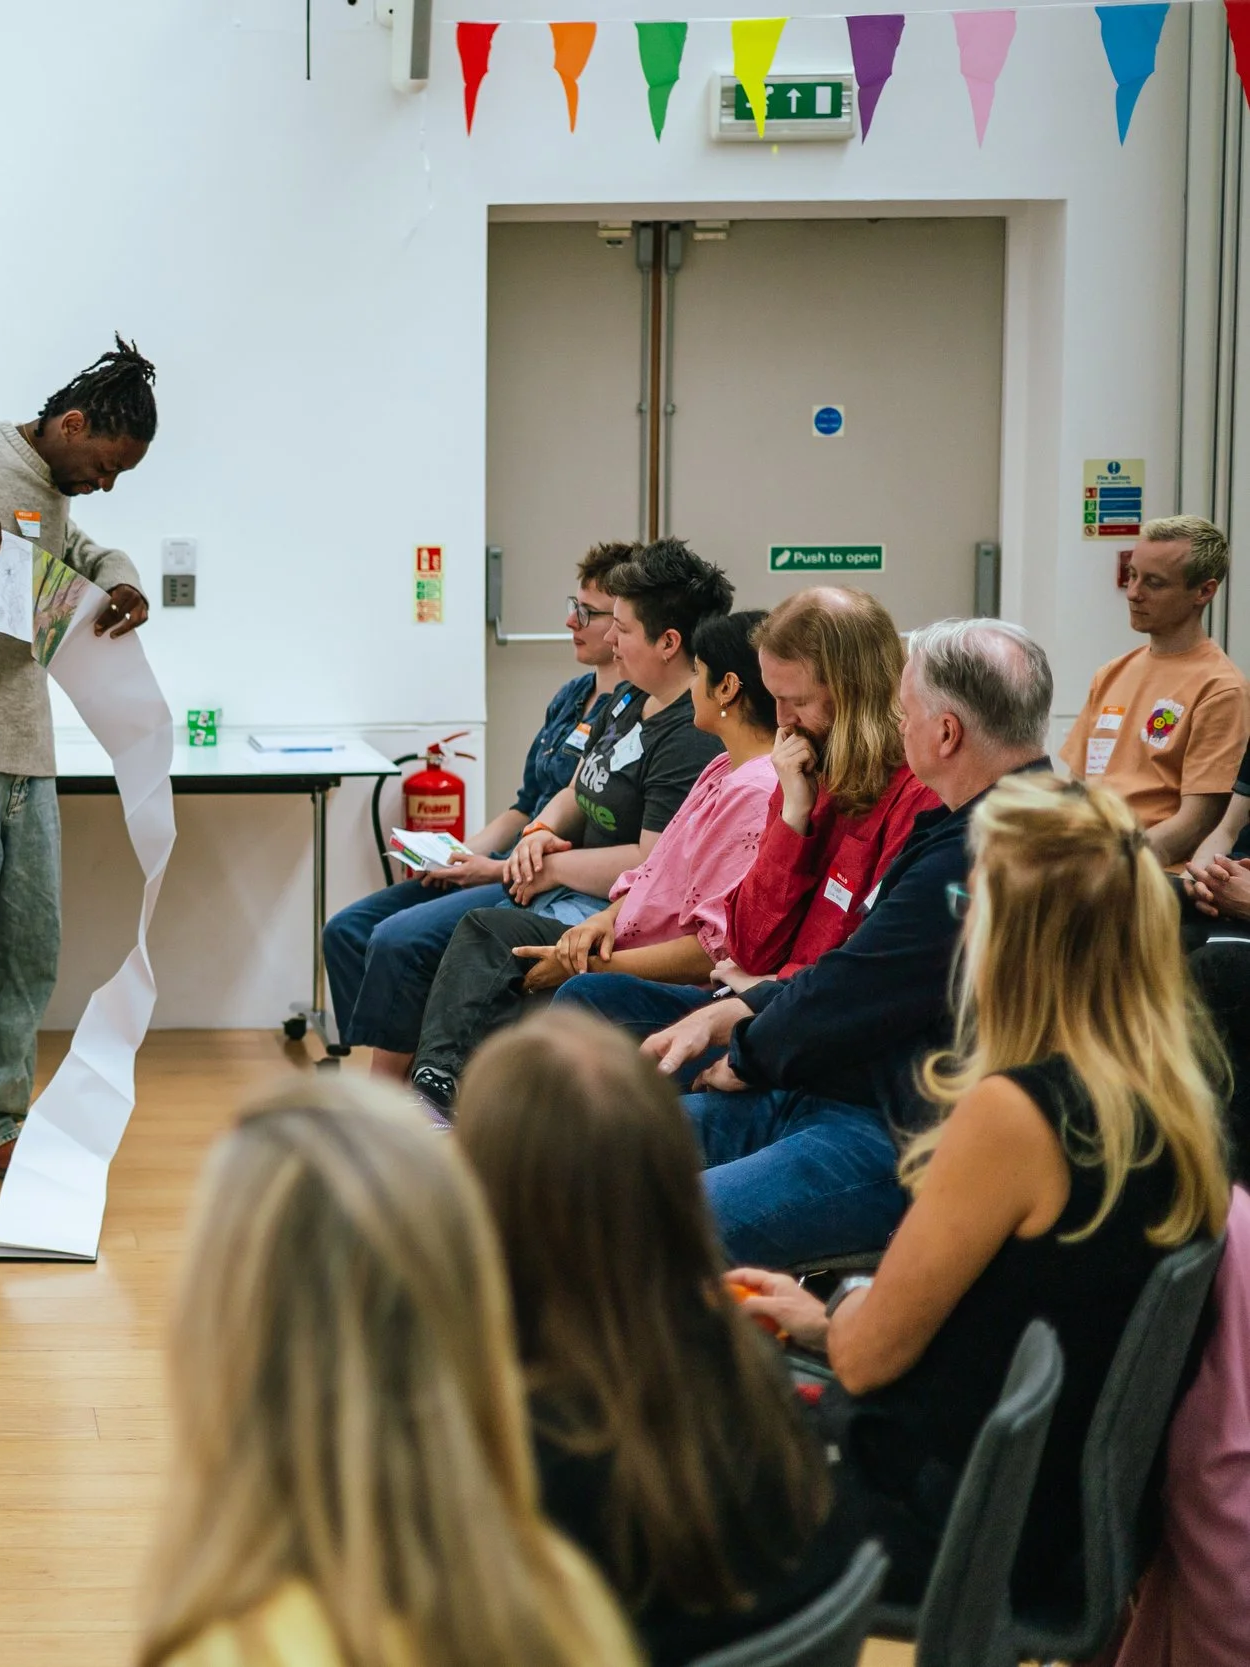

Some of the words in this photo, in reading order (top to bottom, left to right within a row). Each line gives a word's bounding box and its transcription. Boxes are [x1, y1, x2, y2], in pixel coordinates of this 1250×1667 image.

[793, 551, 826, 564] Push
[829, 552, 843, 564] to
[846, 552, 879, 565] open
[417, 801, 452, 814] Foam
